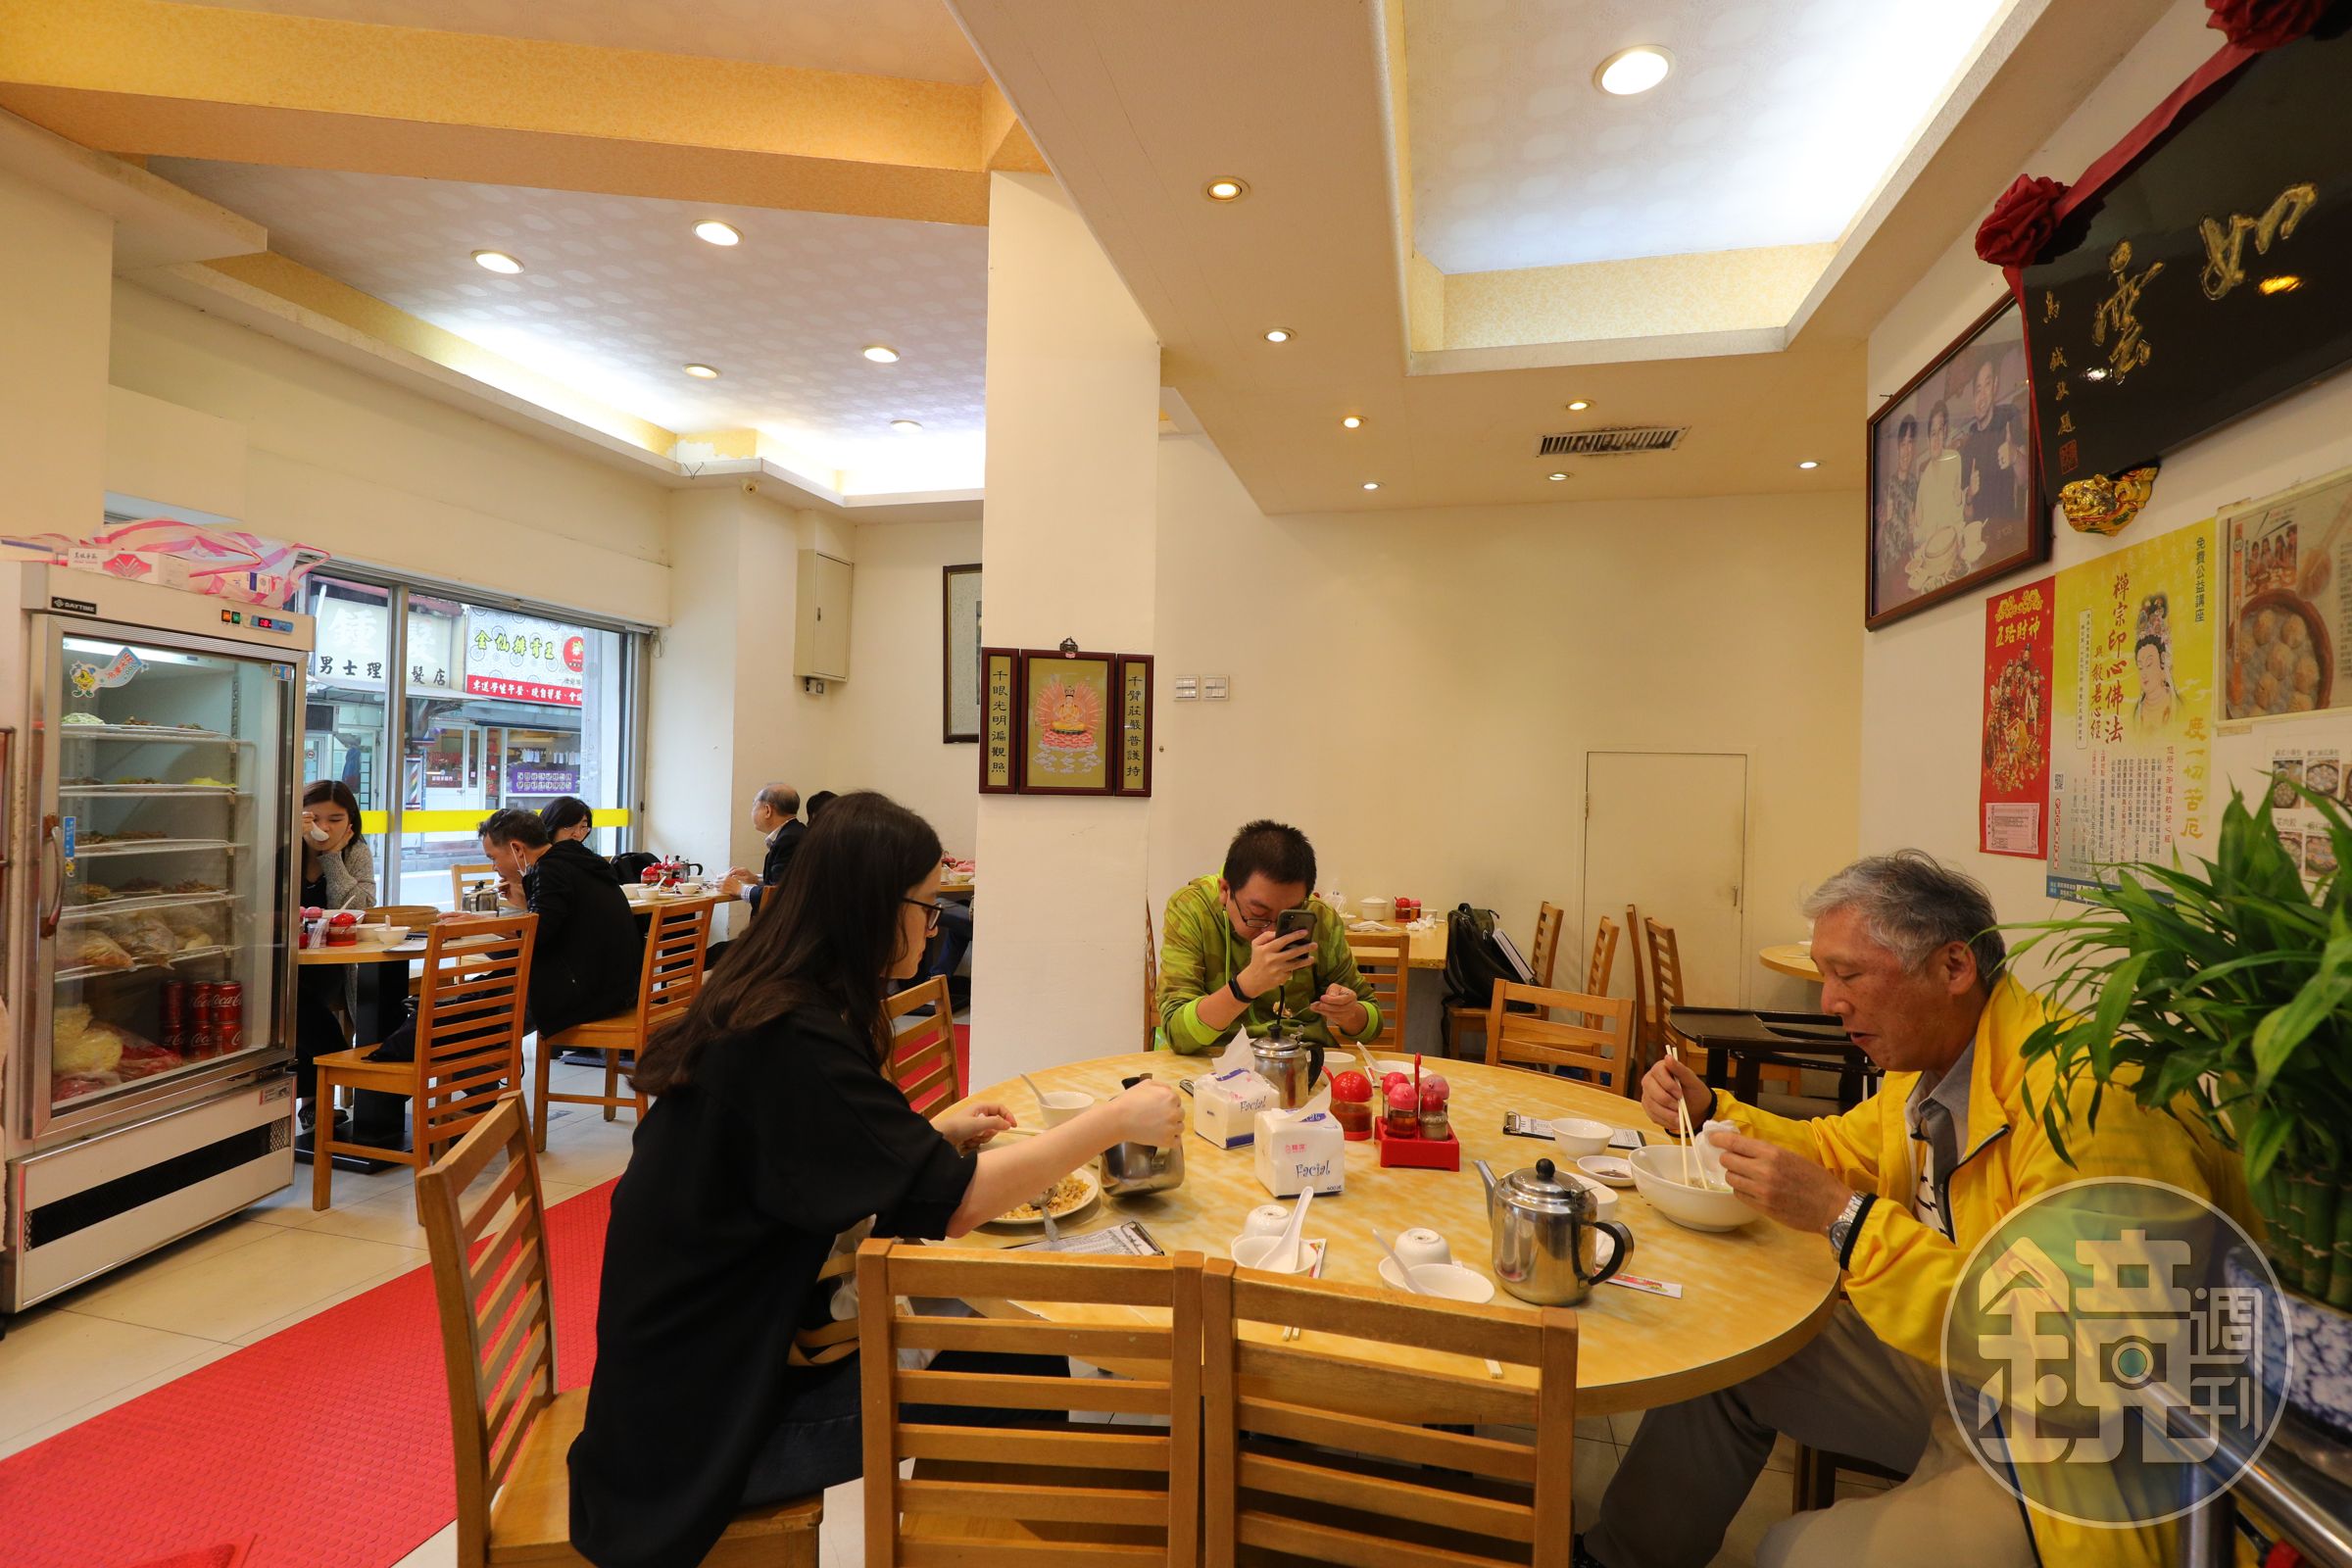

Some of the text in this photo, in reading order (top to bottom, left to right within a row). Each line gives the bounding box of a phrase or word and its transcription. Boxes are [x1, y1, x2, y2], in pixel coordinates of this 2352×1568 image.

[2194, 536, 2206, 623] 免費公益講座
[1995, 615, 2041, 648] 五路財神
[2104, 573, 2130, 745] 禪宗印心佛法
[319, 656, 446, 686] 男士理髮店
[1126, 675, 1143, 777] 千臂莊嚴普護持
[2180, 716, 2206, 840] 度一切苦厄
[1240, 1096, 1267, 1113] Facial
[1295, 1160, 1331, 1179] Facial
